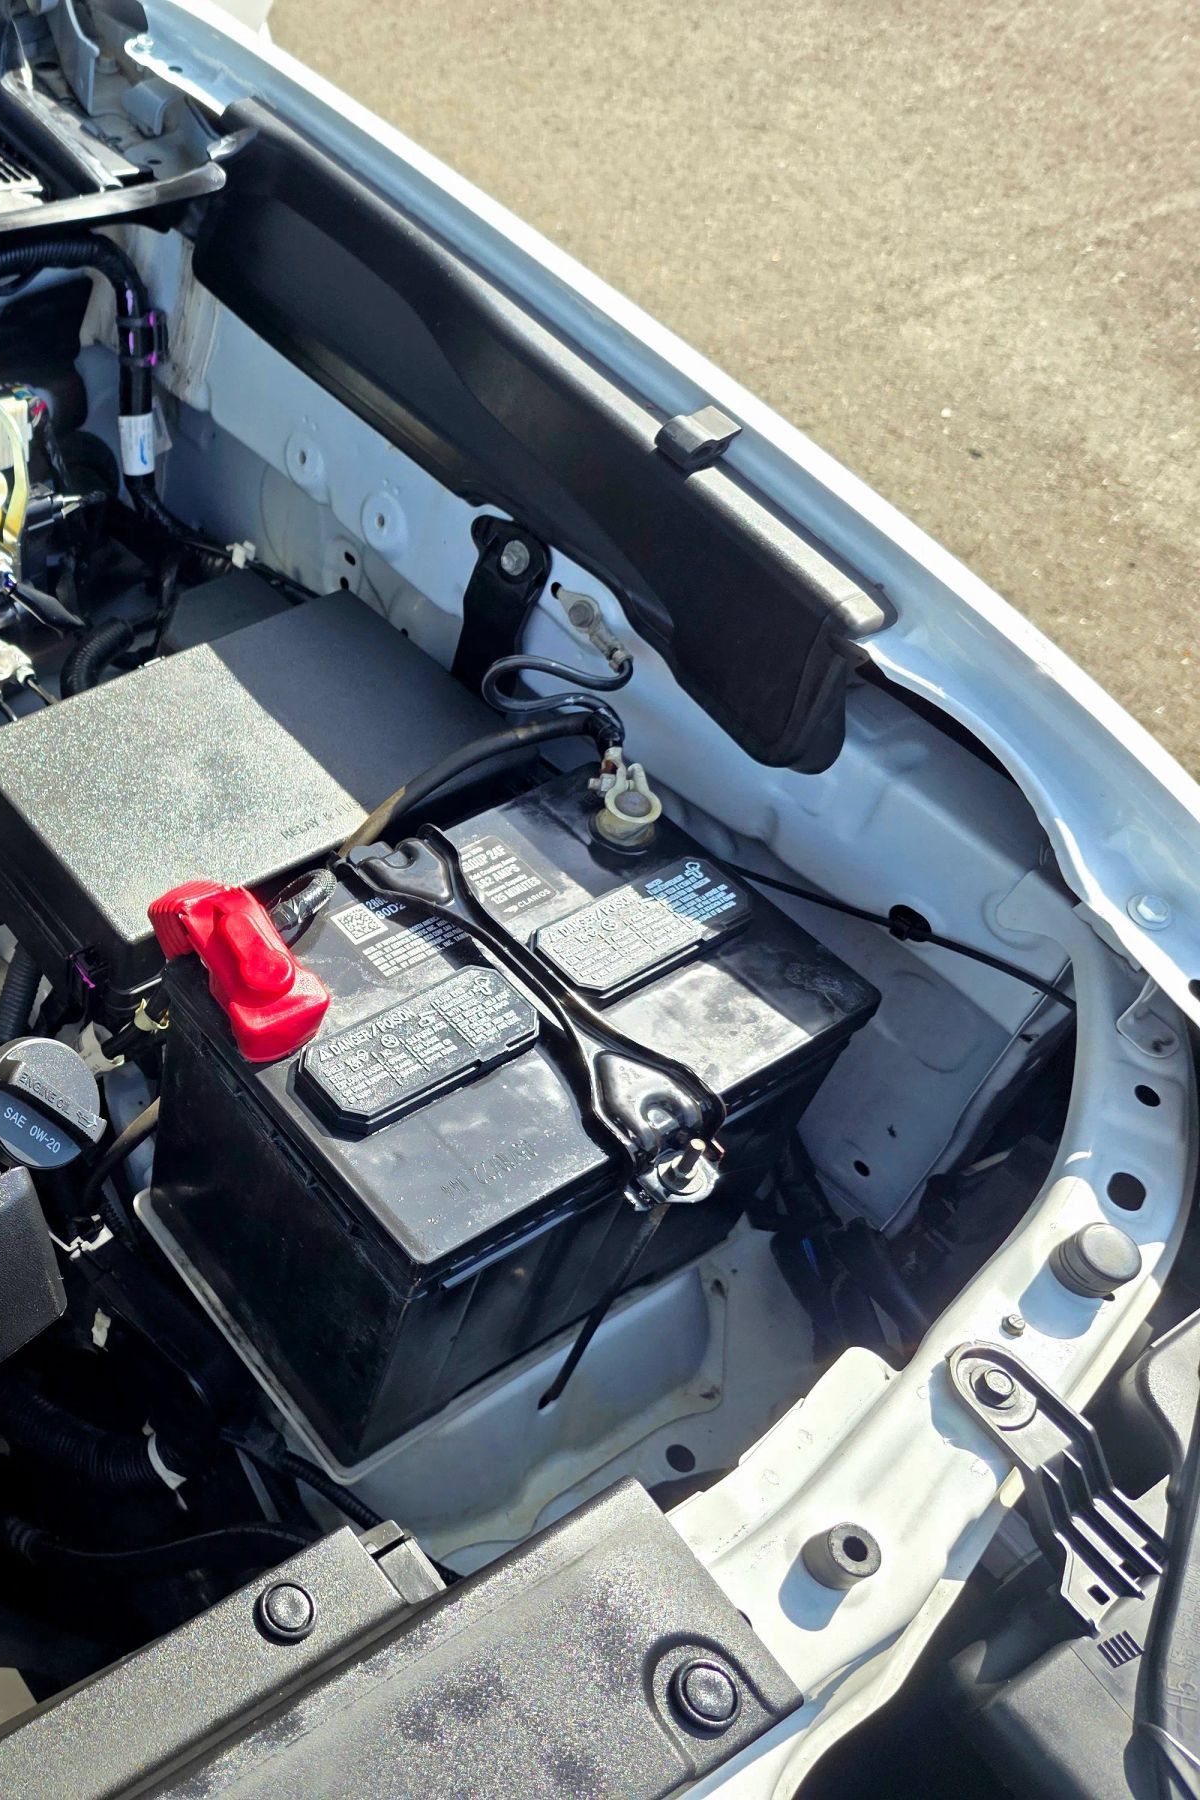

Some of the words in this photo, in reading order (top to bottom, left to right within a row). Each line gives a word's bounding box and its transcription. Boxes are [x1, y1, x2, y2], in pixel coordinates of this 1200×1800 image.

[492, 862, 520, 881] AMPS
[489, 891, 508, 905] 125
[504, 875, 542, 898] MINUTES
[516, 887, 551, 907] CLARIOS
[18, 1073, 60, 1104] ENGINE
[55, 1097, 71, 1116] OIL
[4, 1107, 28, 1129] SAE
[29, 1125, 61, 1154] 0W-20
